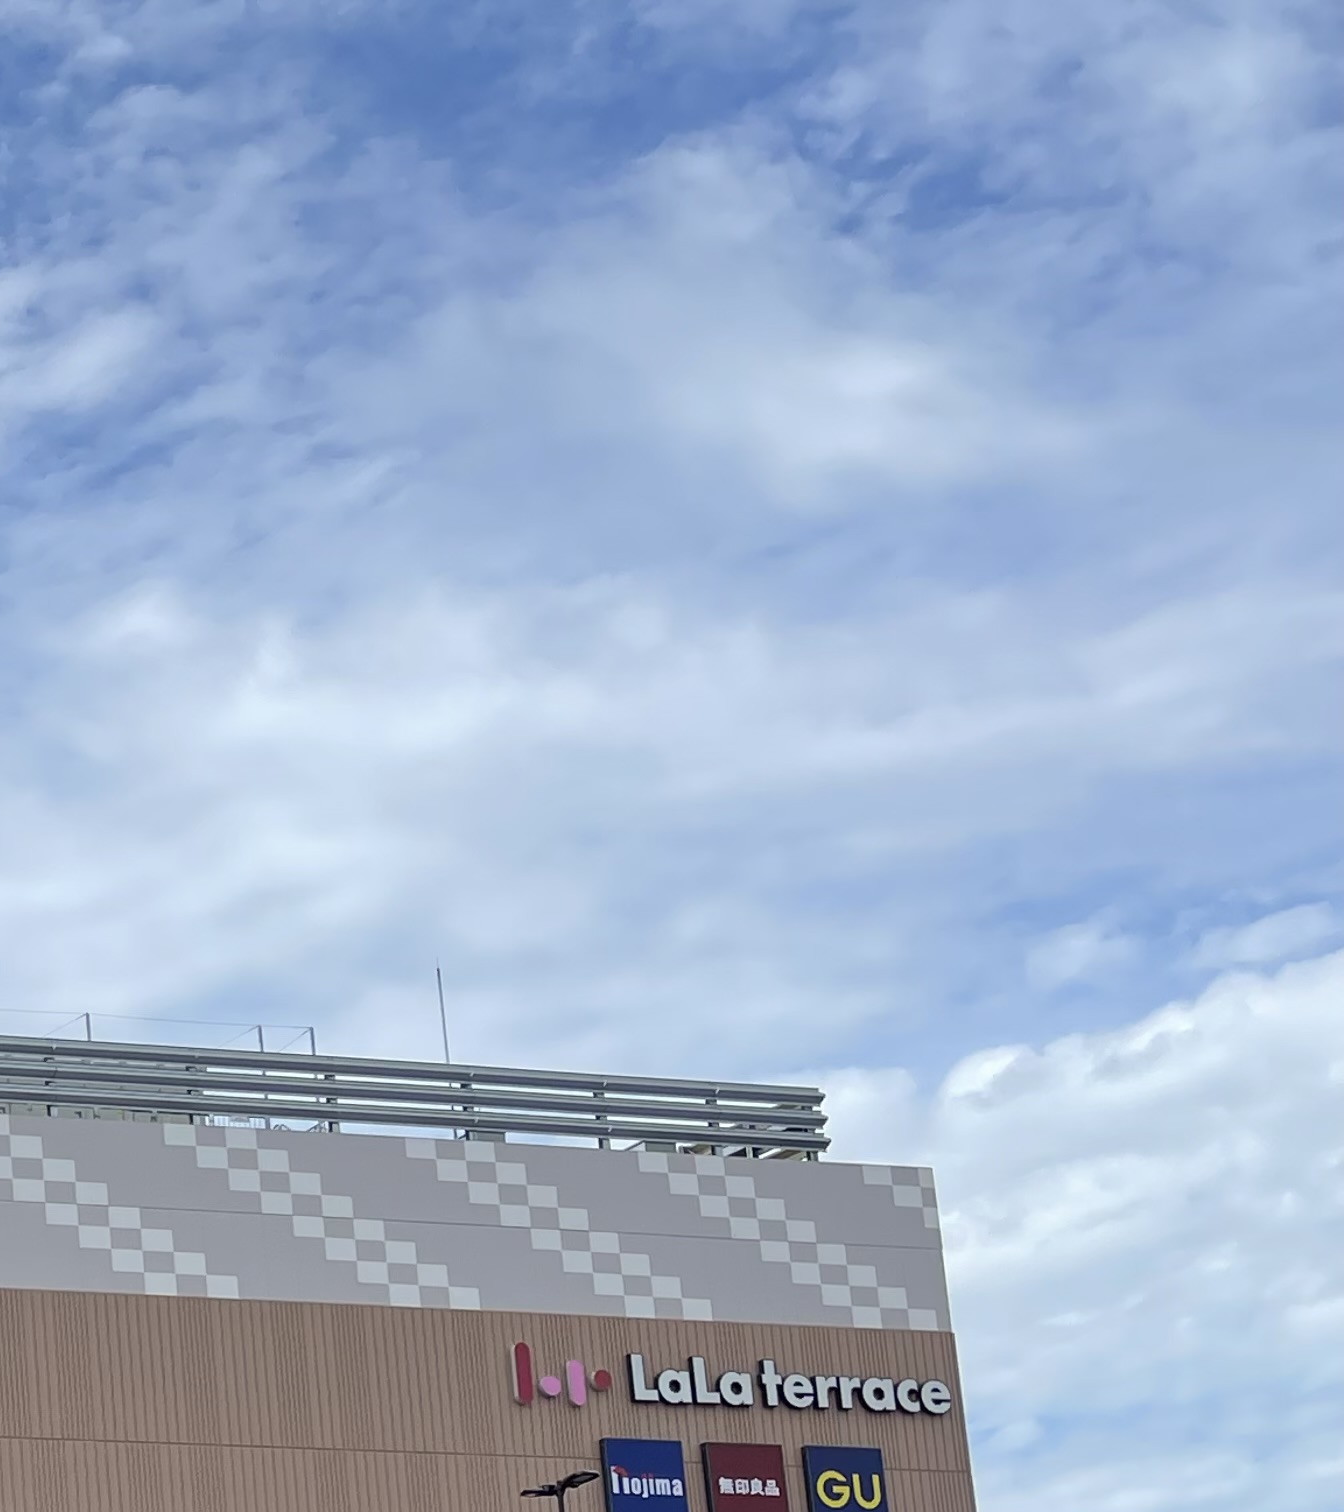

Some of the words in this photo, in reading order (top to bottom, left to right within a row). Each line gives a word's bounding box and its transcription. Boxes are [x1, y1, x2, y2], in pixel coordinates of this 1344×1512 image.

[627, 1352, 755, 1408] LaLa
[758, 1357, 953, 1416] terrace
[718, 1476, 781, 1497] 無印良品
[816, 1468, 882, 1511] GU
